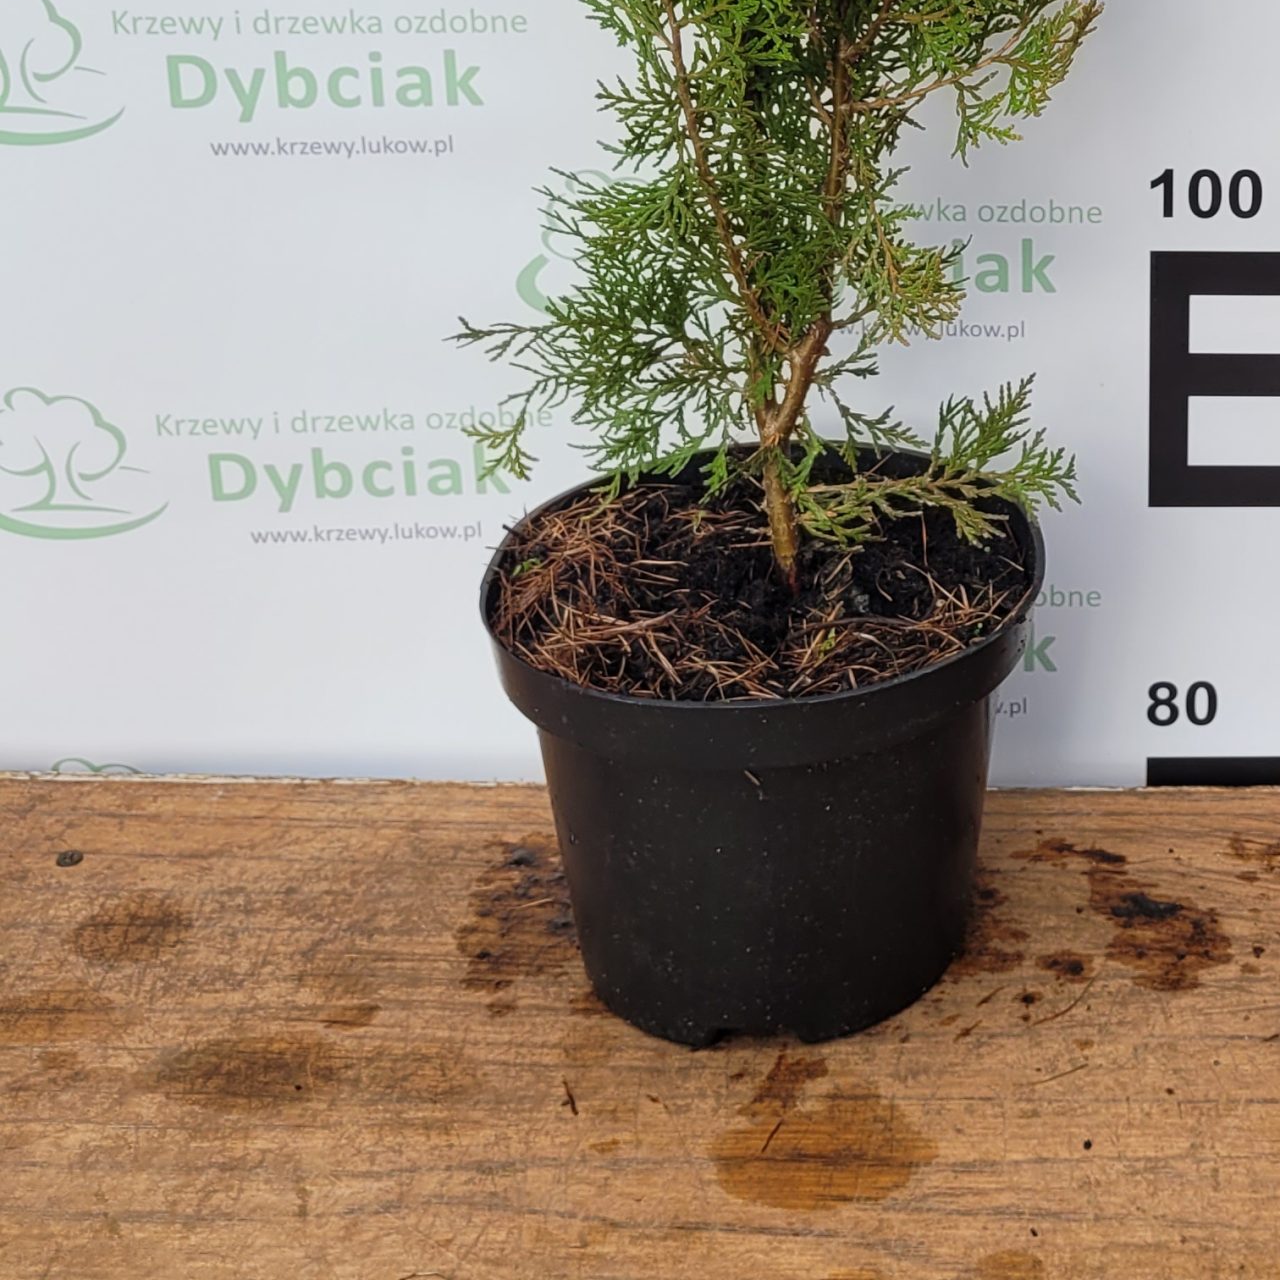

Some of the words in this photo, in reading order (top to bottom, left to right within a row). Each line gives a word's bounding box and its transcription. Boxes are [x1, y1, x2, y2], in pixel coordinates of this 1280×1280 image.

[111, 10, 224, 40] Krzewy
[234, 10, 242, 35] i
[252, 9, 384, 35] drzewka
[394, 9, 528, 34] ozdobne
[166, 49, 485, 123] Dybciak
[210, 134, 454, 159] www.krzewy.lukow.pl
[1150, 168, 1263, 219] 100
[978, 199, 1103, 223] ozdobne
[155, 413, 262, 440] Krzewy
[273, 412, 280, 435] i
[290, 407, 415, 434] drzewka
[207, 446, 511, 513] Dybciak
[250, 521, 483, 545] www.krzewy.lukow.pl
[1147, 681, 1217, 726] 80
